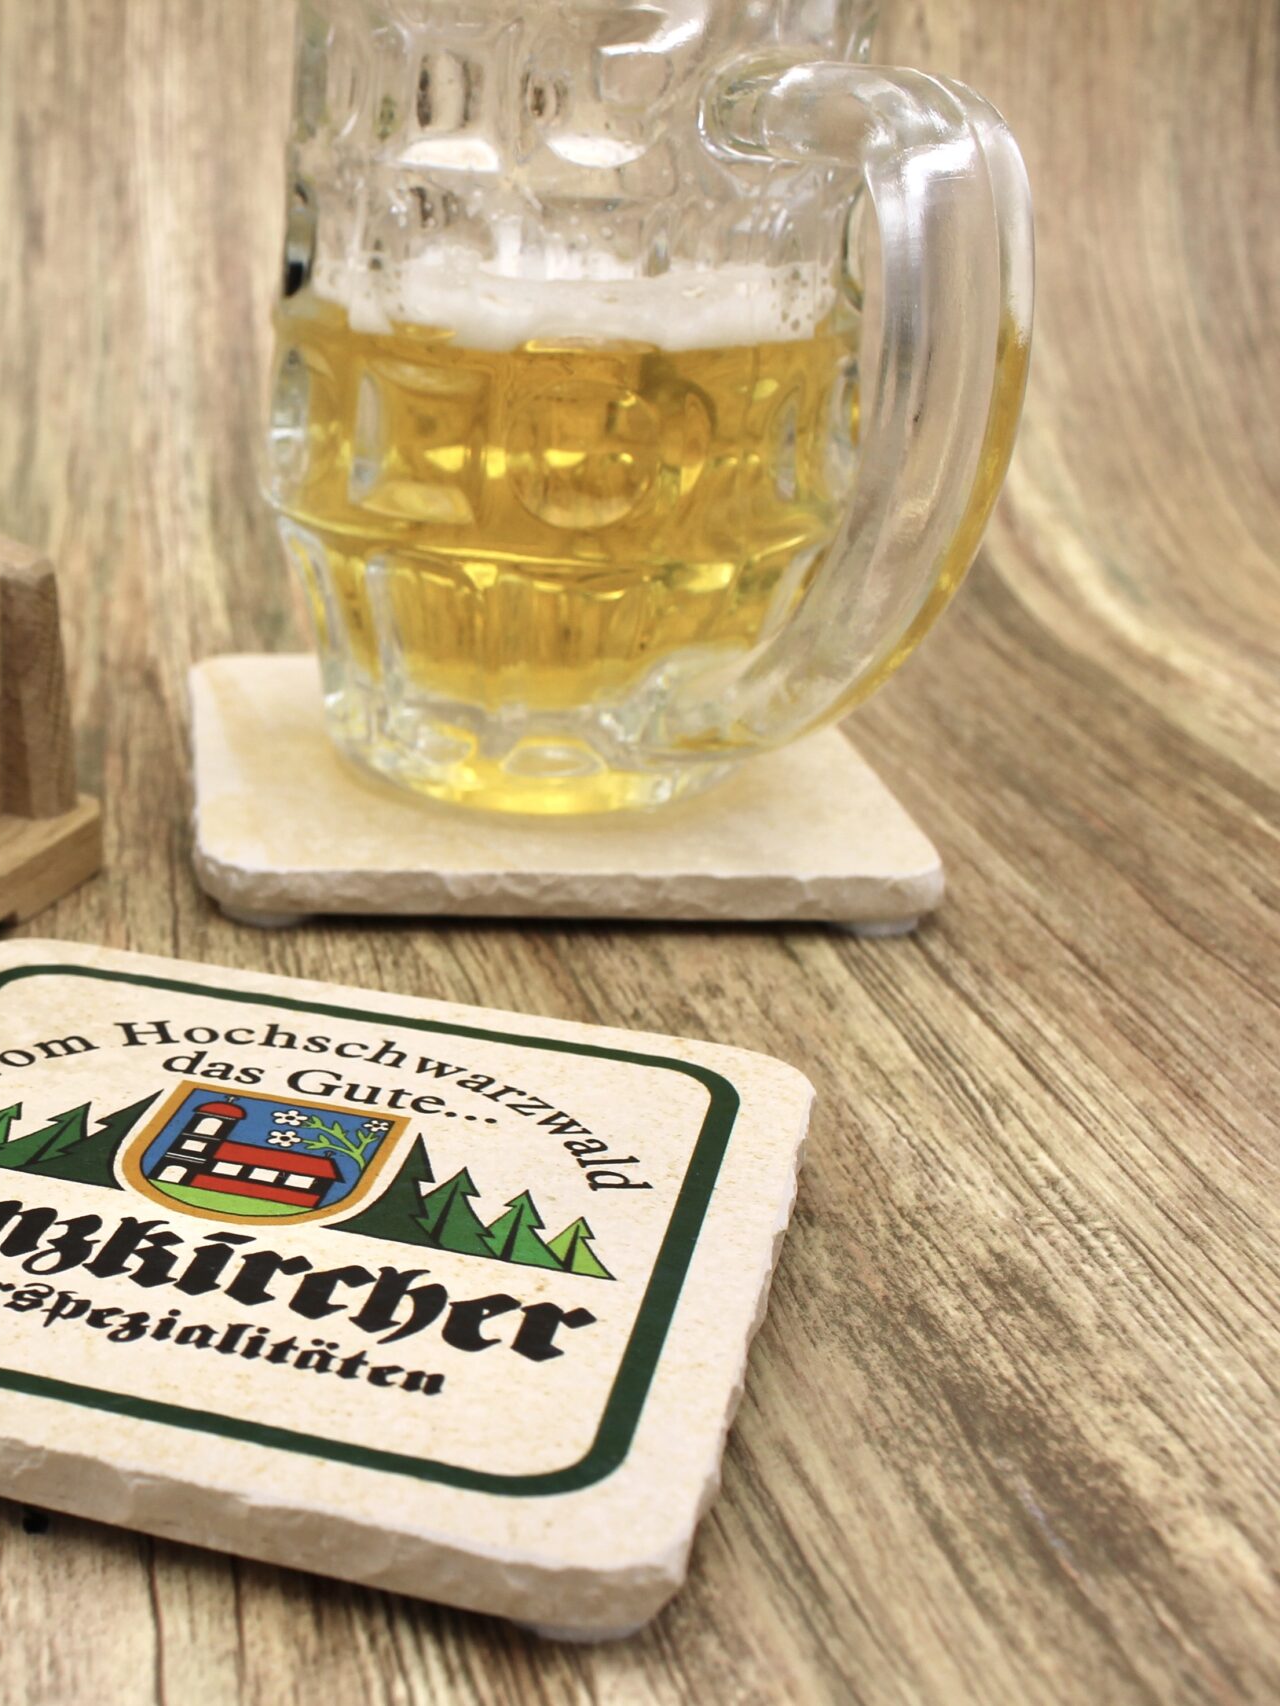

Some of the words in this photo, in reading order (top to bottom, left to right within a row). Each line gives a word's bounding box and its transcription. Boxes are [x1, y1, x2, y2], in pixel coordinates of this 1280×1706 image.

[115, 1020, 652, 1193] Hochschwarzwald
[163, 1050, 266, 1085] das
[286, 1069, 499, 1125] Gute...
